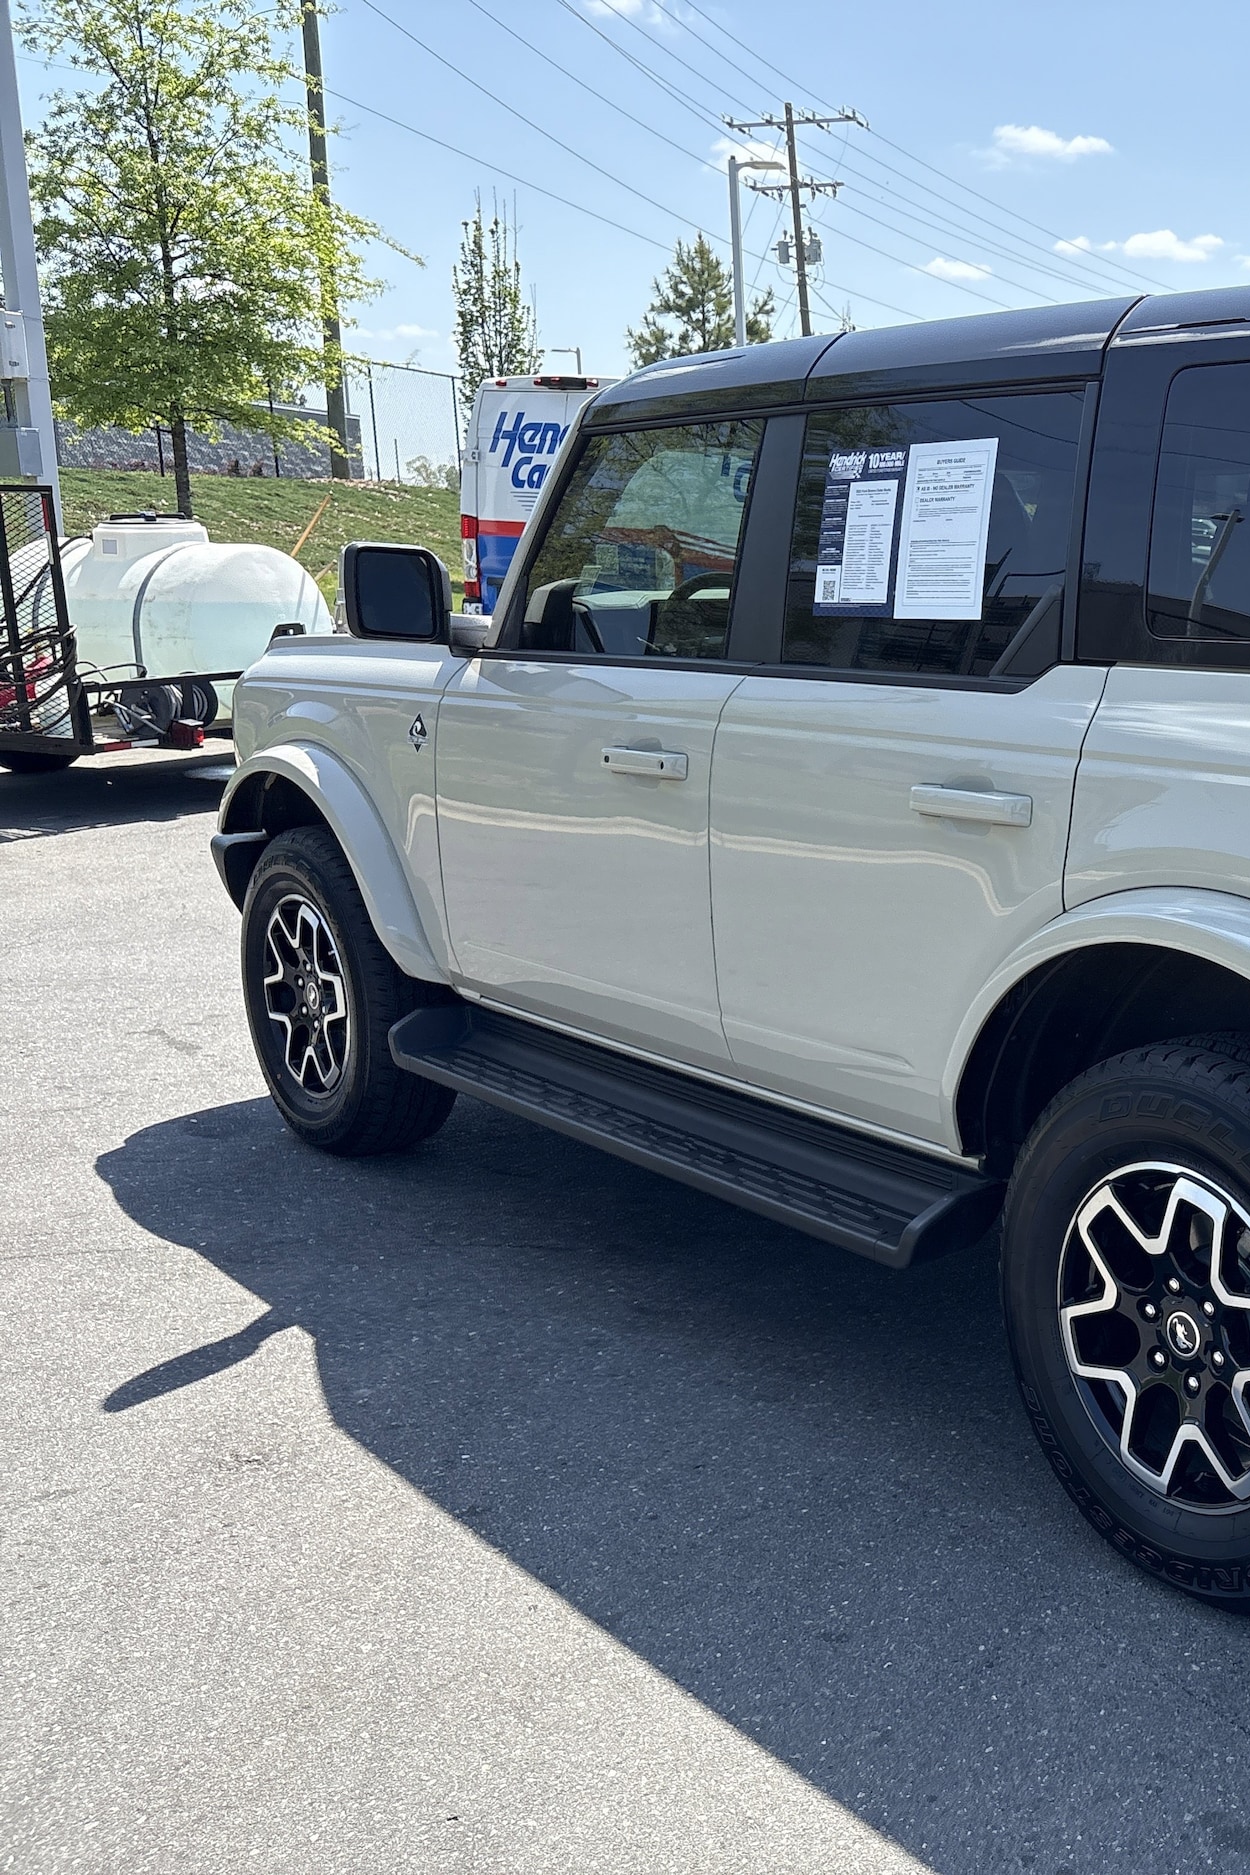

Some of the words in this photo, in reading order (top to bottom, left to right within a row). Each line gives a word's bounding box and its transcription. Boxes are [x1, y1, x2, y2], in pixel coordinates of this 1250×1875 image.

[489, 411, 571, 468] Hen
[511, 456, 551, 489] Ca
[829, 451, 867, 472] Hendrick
[869, 453, 880, 468] 10
[880, 451, 906, 461] YEAR/
